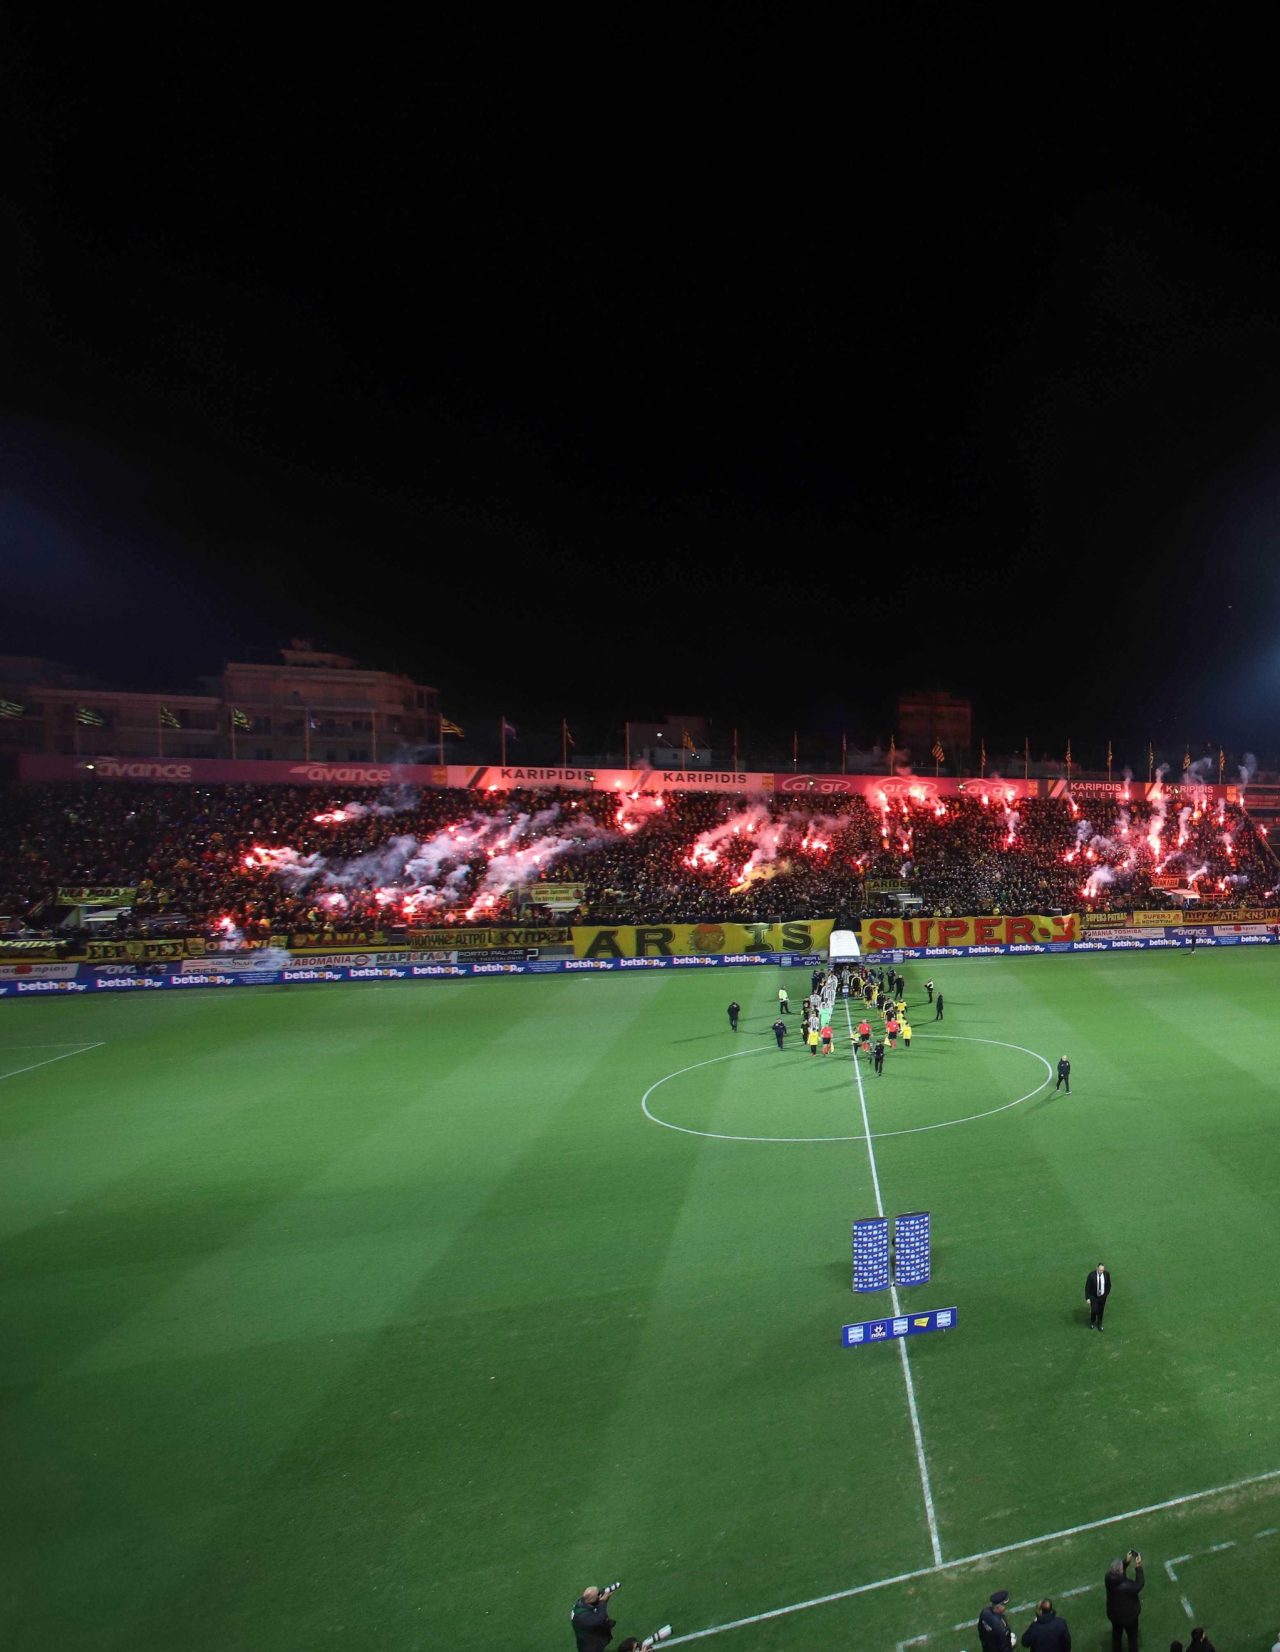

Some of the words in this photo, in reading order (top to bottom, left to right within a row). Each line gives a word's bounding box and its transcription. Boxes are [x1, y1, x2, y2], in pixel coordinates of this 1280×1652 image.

[95, 762, 192, 777] avance
[307, 767, 391, 782] avance
[501, 768, 593, 781] KARIPIDIS
[663, 771, 747, 784] KARIPIDIS
[1070, 782, 1122, 791] KARIPIDIS
[1185, 937, 1217, 946] beshop.gr
[620, 957, 667, 968] betshop.gr
[672, 956, 719, 966] betshop.gr
[723, 954, 768, 964] betshop.gr
[472, 963, 526, 973] betshop.gr
[564, 960, 614, 970] betshop.gr
[283, 969, 343, 981] betshop.gr
[349, 965, 406, 977] betshop.gr
[412, 966, 467, 976] betshop.gr
[97, 977, 165, 988] betshop.gr
[171, 974, 235, 986] betshop.gr
[16, 981, 88, 992] betshop.gr
